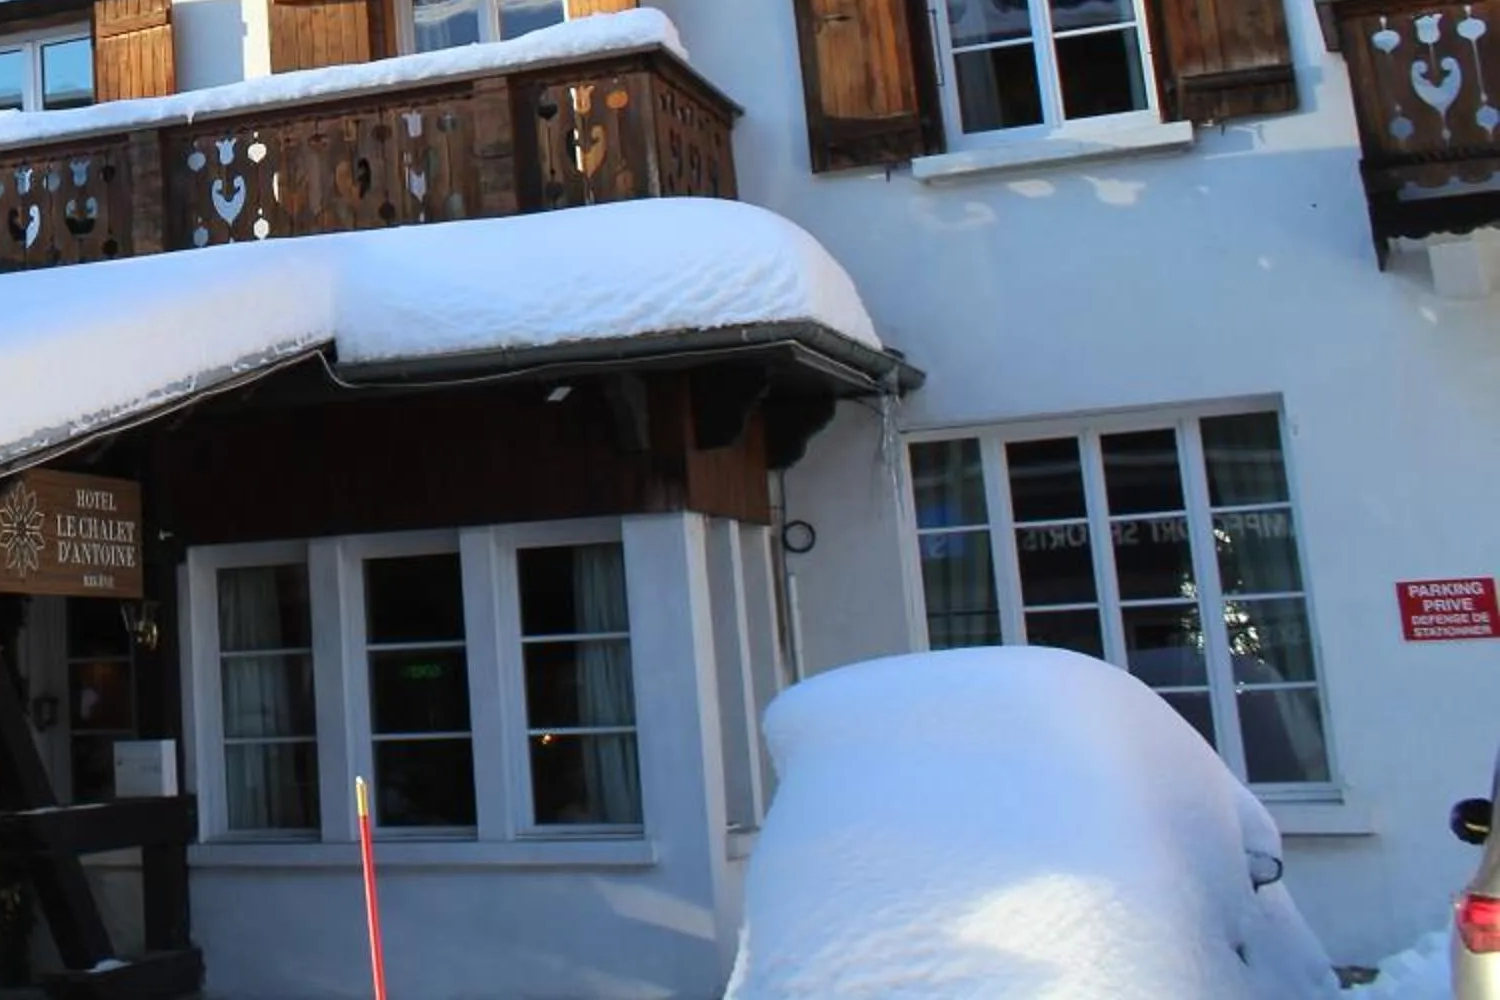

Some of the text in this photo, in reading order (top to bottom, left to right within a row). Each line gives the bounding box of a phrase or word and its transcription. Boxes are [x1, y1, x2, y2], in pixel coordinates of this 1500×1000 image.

[76, 489, 116, 511] HOTEL
[56, 514, 135, 543] LE CHALET
[58, 541, 135, 568] D'ANTOINE
[1408, 581, 1484, 598] PARKING
[1422, 597, 1474, 612] PRIVE
